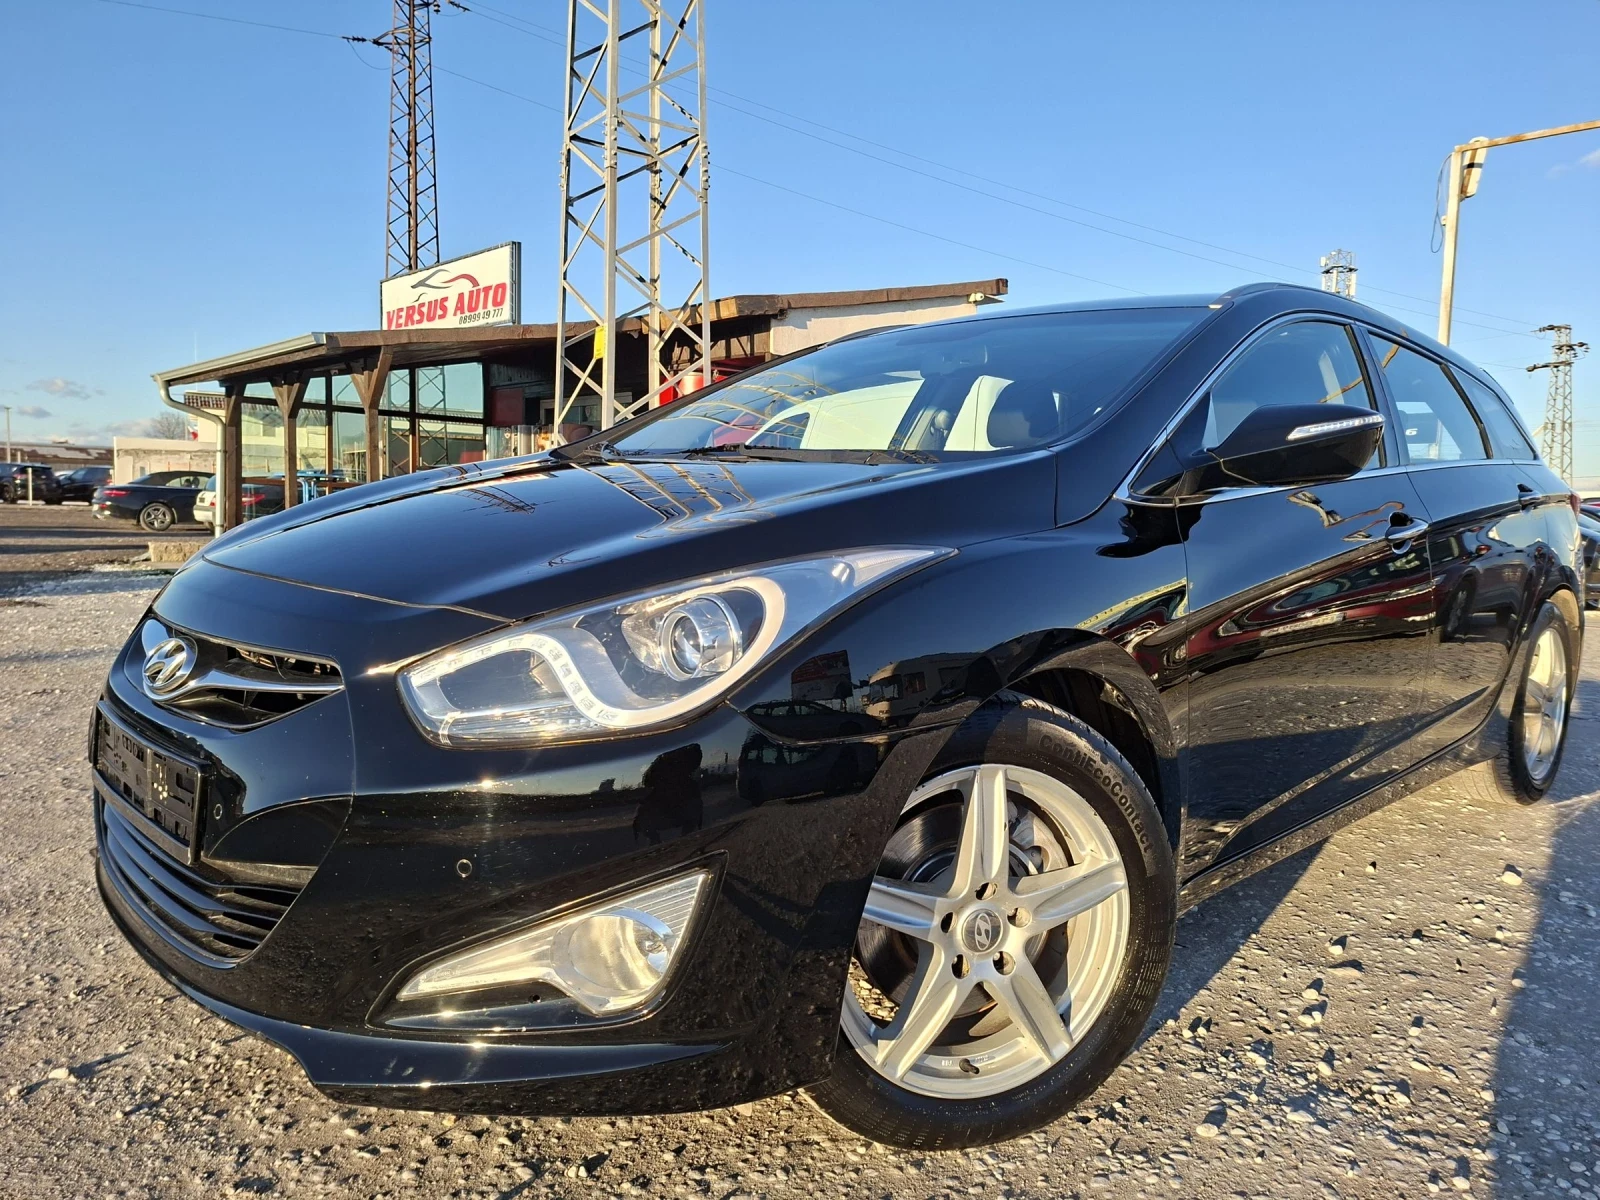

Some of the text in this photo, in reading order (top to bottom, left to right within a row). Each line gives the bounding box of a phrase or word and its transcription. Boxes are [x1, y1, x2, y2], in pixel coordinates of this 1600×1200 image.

[386, 282, 507, 330] VERSUS AUTO
[492, 307, 504, 319] 777
[1040, 734, 1155, 853] ContiEcoContact
